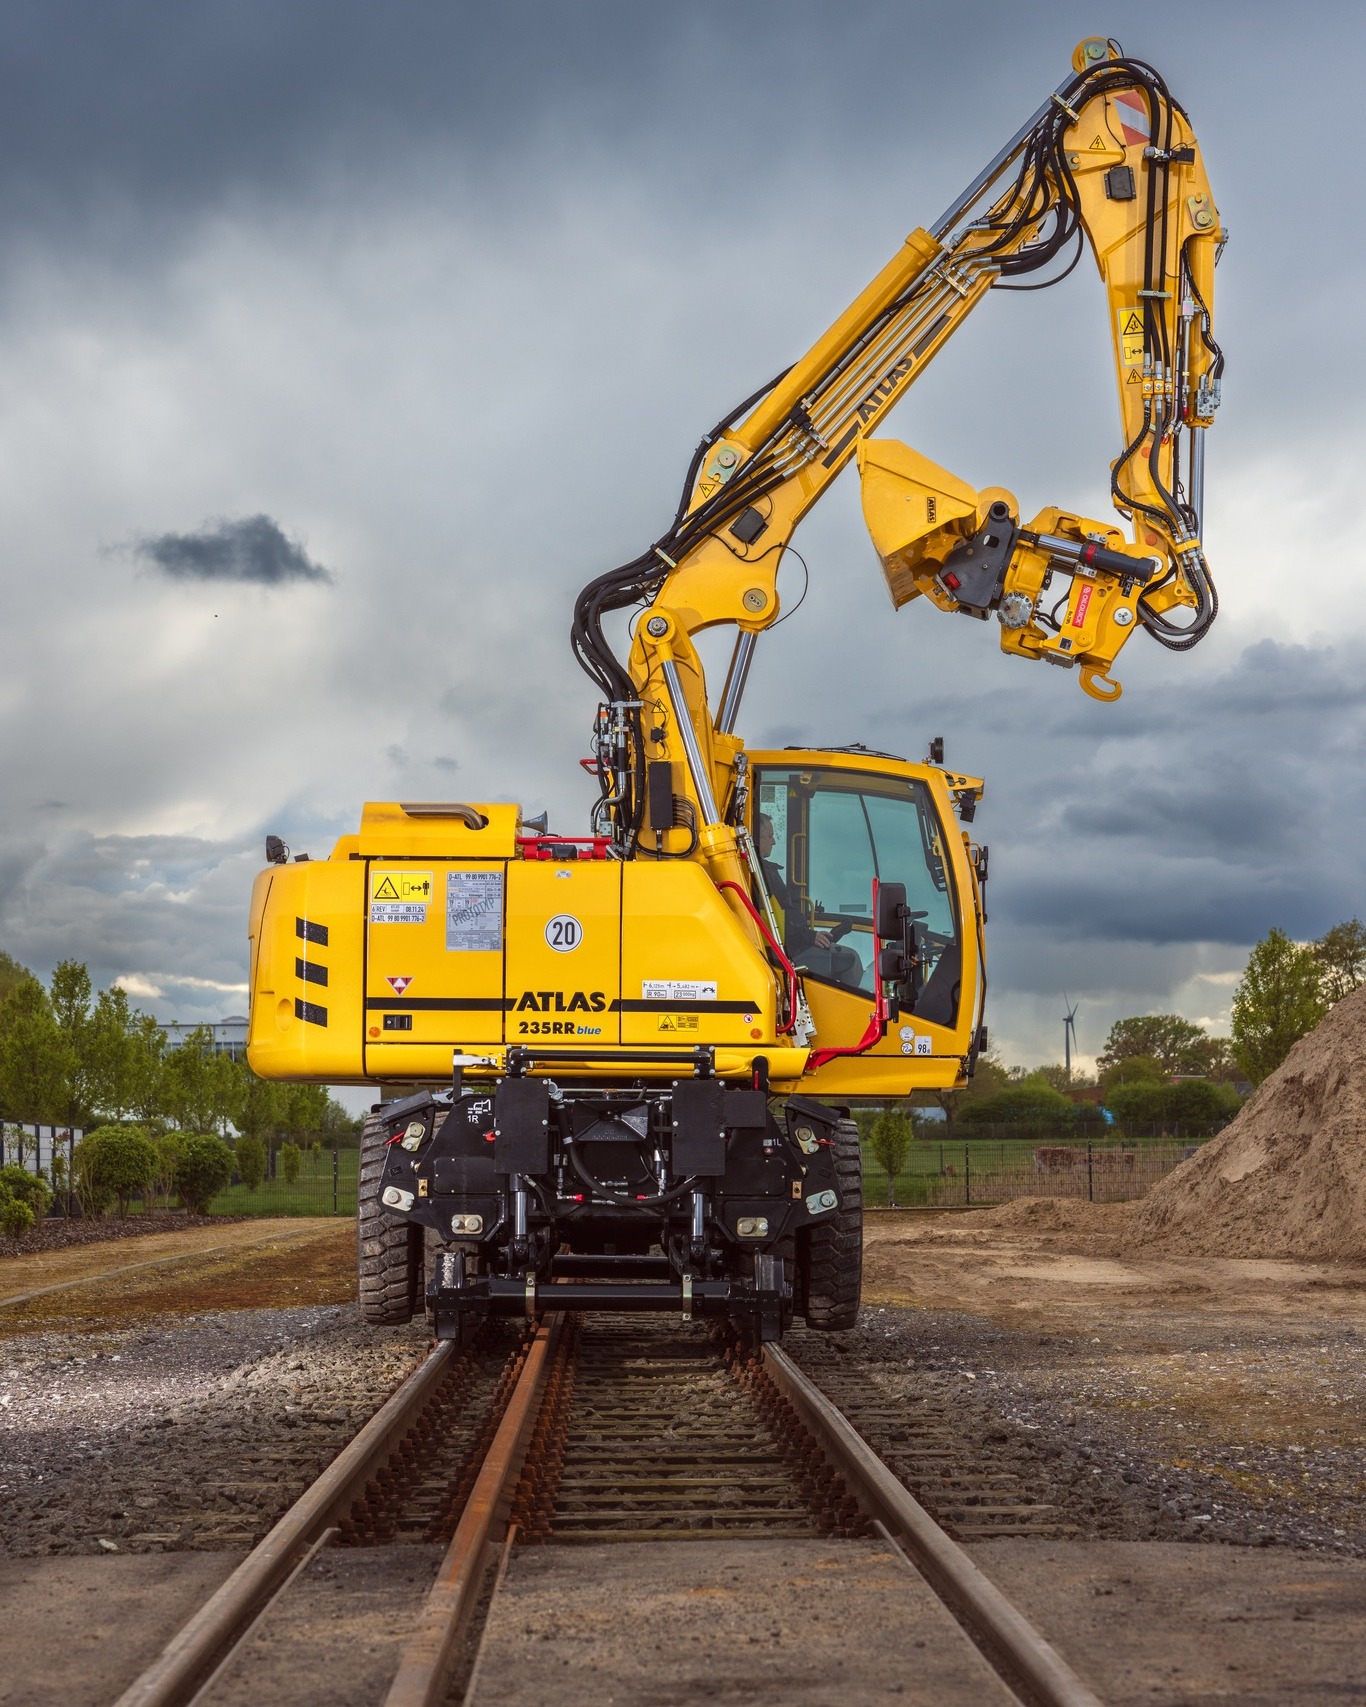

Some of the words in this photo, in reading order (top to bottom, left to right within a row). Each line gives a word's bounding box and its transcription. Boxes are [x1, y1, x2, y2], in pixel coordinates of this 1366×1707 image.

[856, 355, 913, 424] ATLAS
[1075, 595, 1089, 627] OILQUICK
[552, 922, 575, 946] 20
[516, 991, 606, 1012] ATLAS
[518, 1021, 575, 1035] 235RR
[577, 1025, 602, 1036] blue
[917, 1043, 927, 1053] 98
[773, 1138, 783, 1147] 1L
